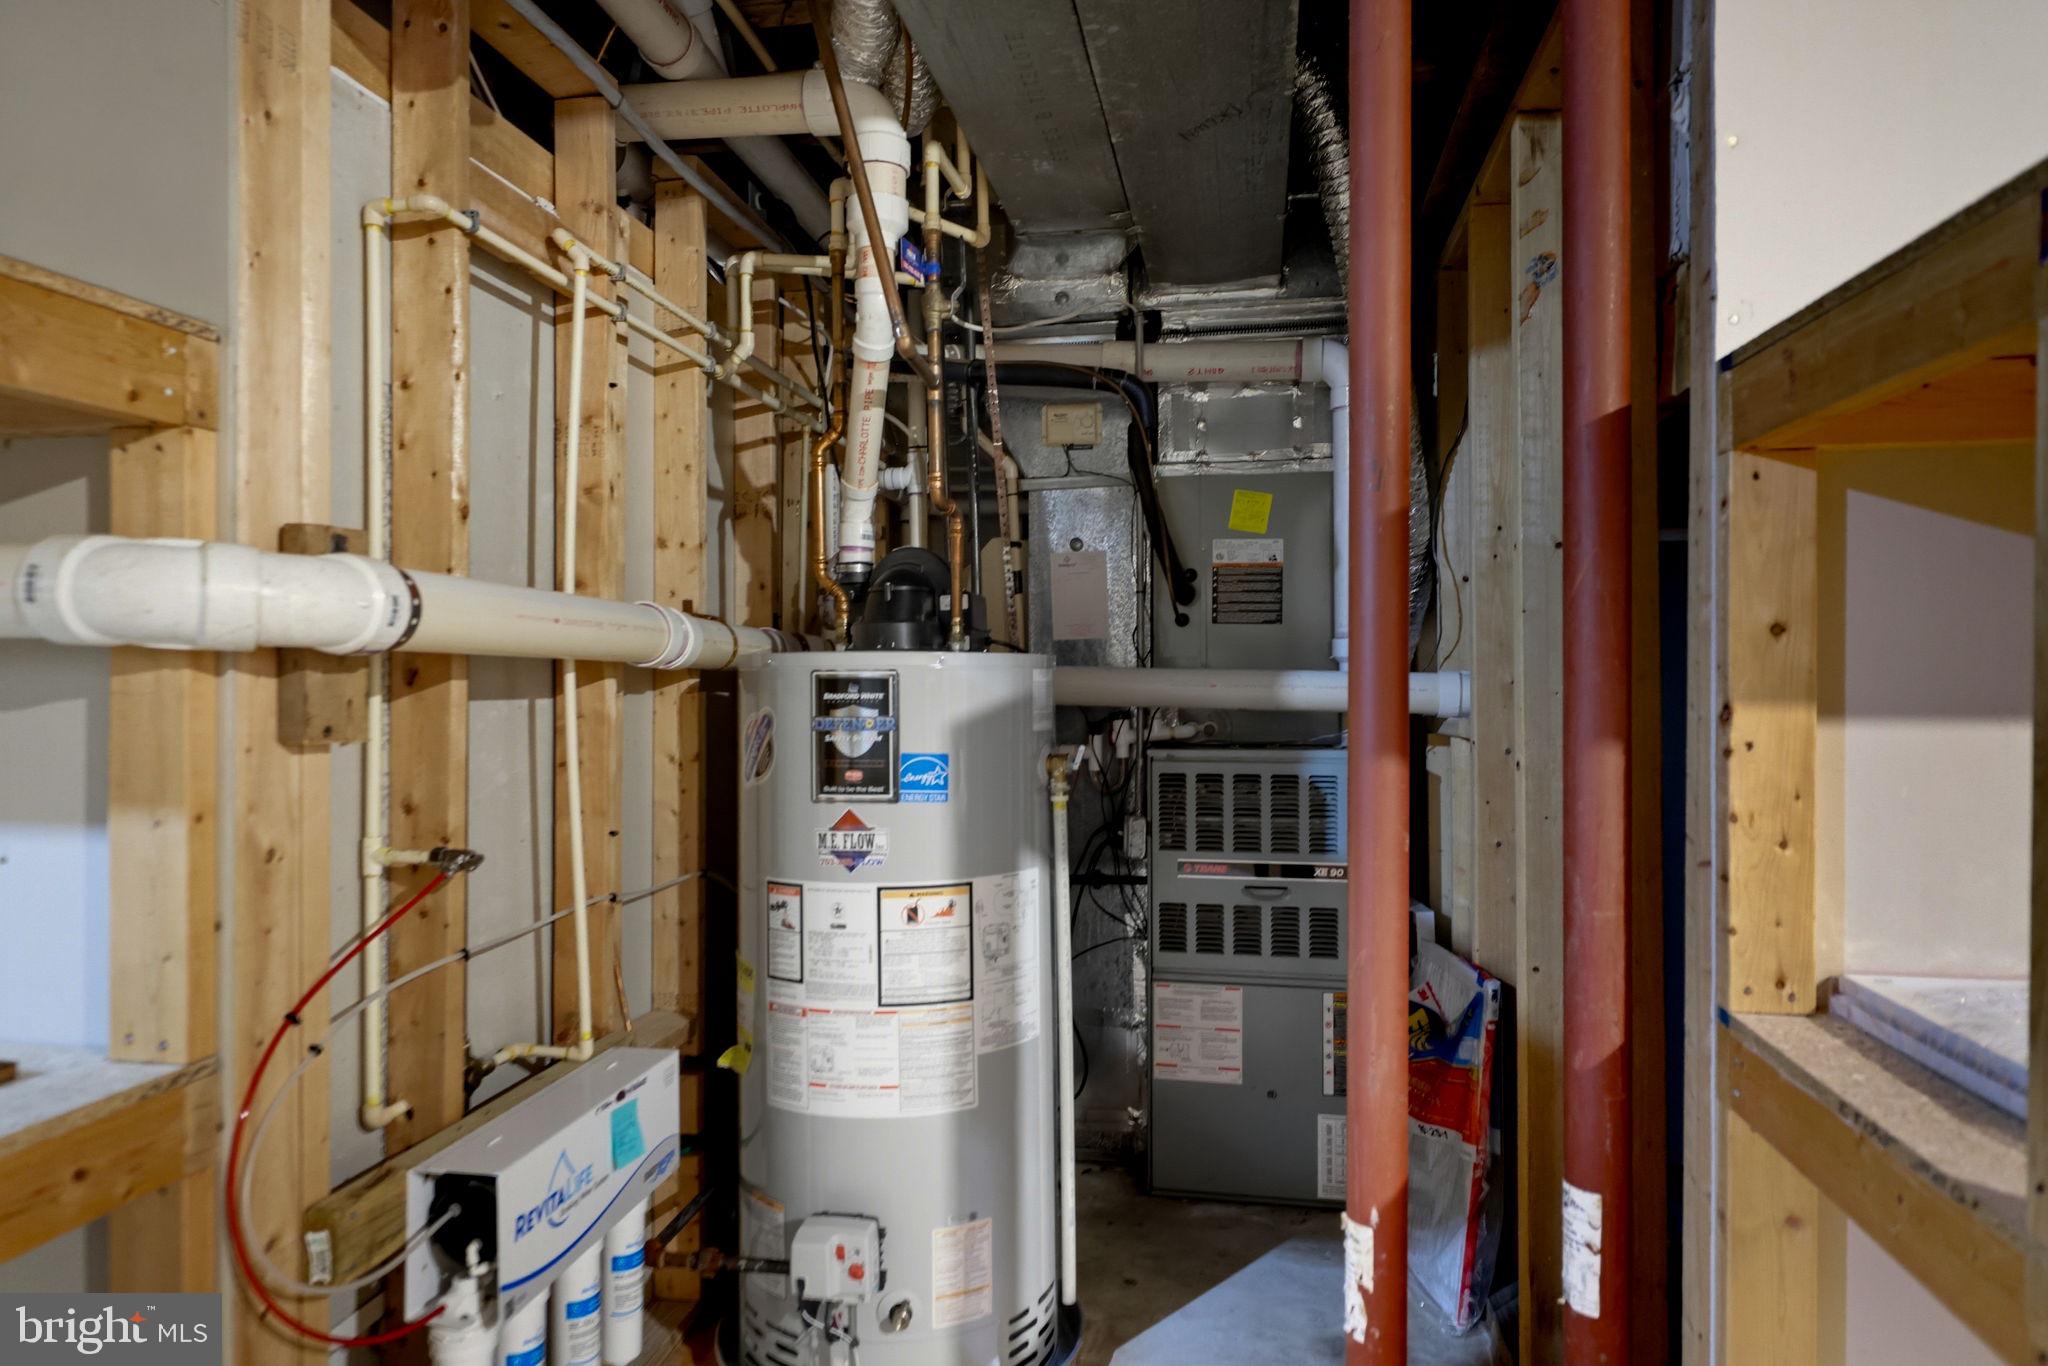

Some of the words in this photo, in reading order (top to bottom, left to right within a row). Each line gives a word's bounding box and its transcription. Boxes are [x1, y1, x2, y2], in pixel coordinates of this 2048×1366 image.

[863, 387, 874, 411] PIPE
[857, 416, 872, 466] CHARLOTTE
[860, 692, 885, 700] WHITE
[812, 717, 896, 732] DEFENDER
[901, 793, 927, 802] ENERGY
[929, 793, 947, 802] STAR
[818, 832, 840, 850] M.E.
[843, 832, 876, 850] FLOW
[1193, 863, 1229, 875] TRANE
[1330, 868, 1345, 878] 90
[513, 1163, 594, 1243] REVITALIFE
